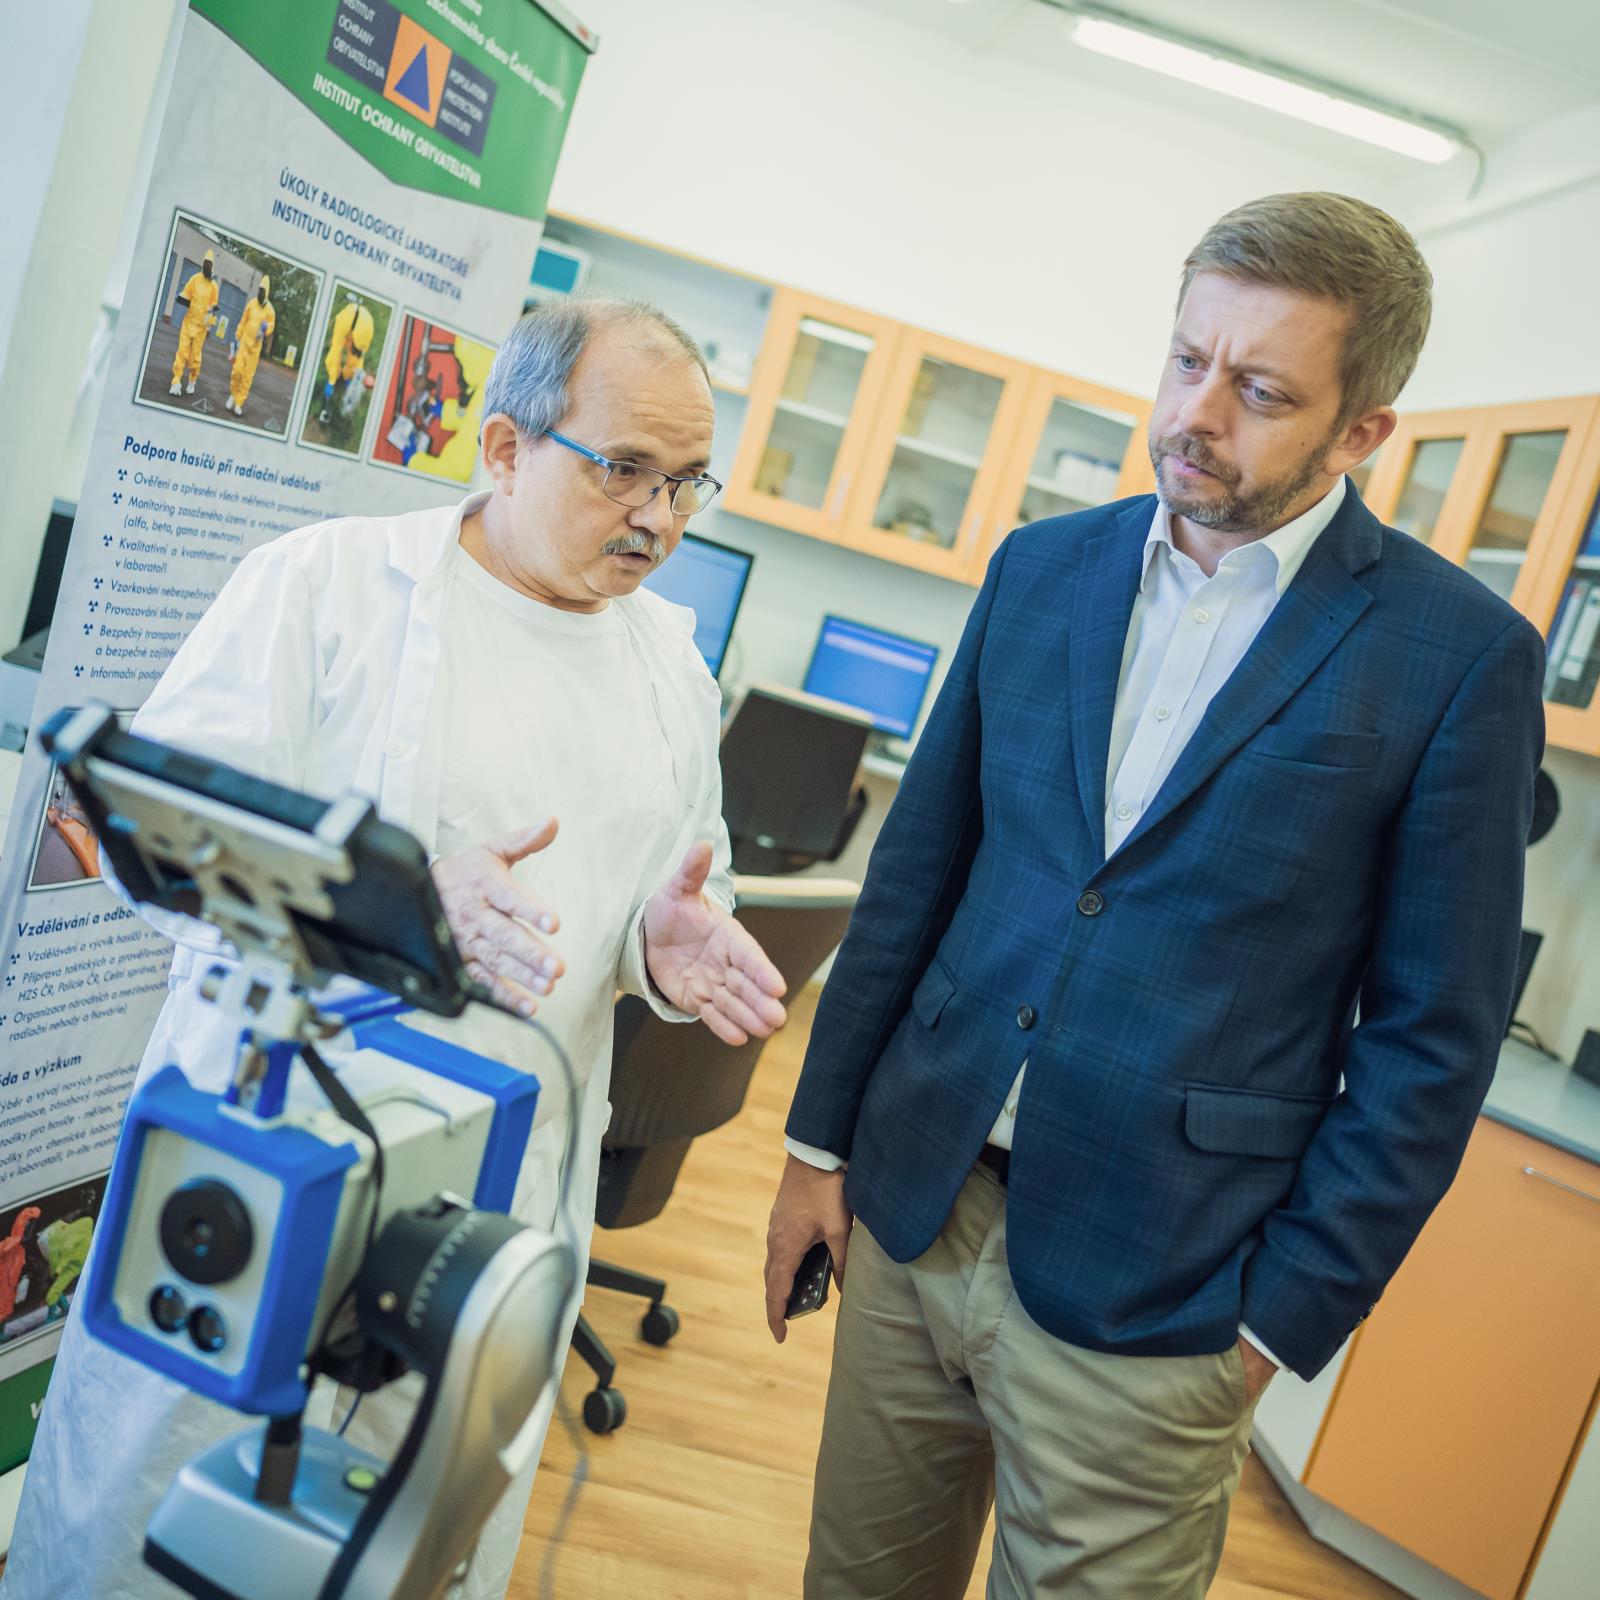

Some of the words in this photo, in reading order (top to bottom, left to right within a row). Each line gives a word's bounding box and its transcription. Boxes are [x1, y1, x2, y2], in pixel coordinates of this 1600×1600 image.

[338, 14, 375, 47] OCHRANY
[333, 36, 386, 80] OBYVATELSTVA
[312, 72, 362, 116] INSTITUT
[361, 104, 416, 147] OCHRANY
[414, 136, 482, 188] OBYVATELSTVA
[279, 166, 319, 203] ÚKOLY
[320, 191, 405, 246] RADIOLOGICKÉ
[404, 234, 470, 278] LABORATOŘE
[272, 199, 332, 241] INSTITUTU
[334, 229, 391, 266] OCHRANY
[391, 257, 463, 301] OBYVATELSTVA
[124, 435, 177, 461] Podpora
[180, 448, 215, 470] hasičů
[217, 458, 234, 475] při
[234, 463, 279, 484] radiační
[134, 471, 171, 489] Ověření
[172, 483, 178, 491] a
[128, 495, 176, 517] Monitoring
[124, 514, 149, 533] (alfa,
[152, 520, 174, 536] beta,
[175, 526, 199, 538] gama
[119, 537, 168, 555] Kvalitativní
[171, 548, 177, 556] a
[115, 560, 121, 568] v
[123, 557, 168, 574] laboratoři
[111, 579, 158, 596] Vzorkování
[105, 602, 157, 618] Provozování
[100, 624, 142, 642] Bezpečný
[145, 630, 180, 642] transport
[95, 647, 102, 655] a
[105, 644, 147, 660] bezpečné
[150, 646, 178, 659] zajiště
[90, 666, 135, 679] Informační
[138, 667, 164, 681] podpo
[18, 912, 91, 937] Vzdělávání
[92, 914, 100, 924] a
[103, 906, 135, 922] odbo
[28, 942, 78, 961] Vzdělávání
[80, 943, 87, 951] a
[22, 968, 62, 984] Příprava
[18, 988, 38, 1001] HZS
[13, 1003, 67, 1024] Organizace
[9, 1022, 46, 1042] radiační
[82, 1013, 89, 1022] a
[0, 1071, 18, 1087] da
[23, 1070, 30, 1081] a
[35, 1055, 81, 1079] výzkum
[0, 1097, 23, 1114] ýběr
[26, 1095, 33, 1103] a
